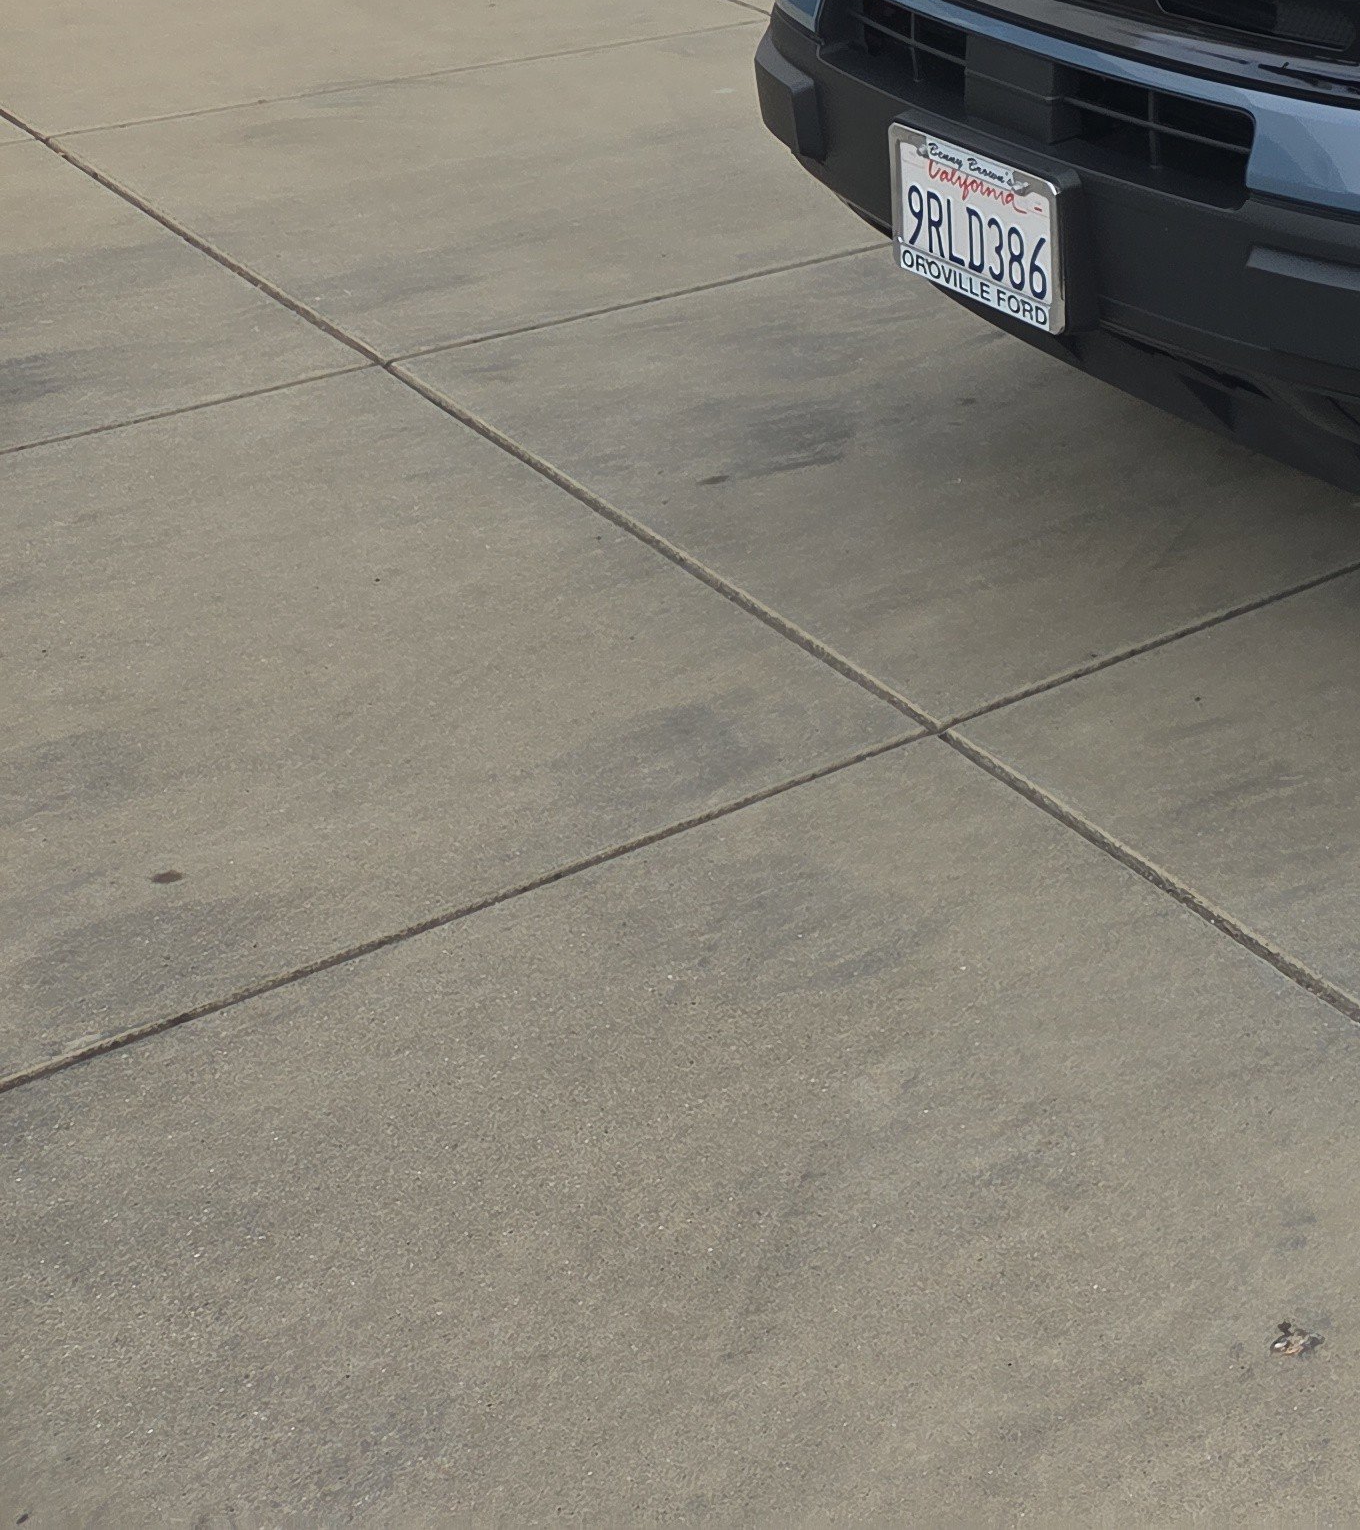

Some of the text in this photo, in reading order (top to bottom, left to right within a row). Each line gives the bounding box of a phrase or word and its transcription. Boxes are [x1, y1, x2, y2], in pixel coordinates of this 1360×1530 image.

[927, 158, 1028, 214] California
[908, 185, 1047, 300] 9RLD386
[902, 250, 1047, 326] OROVILLE FORD
